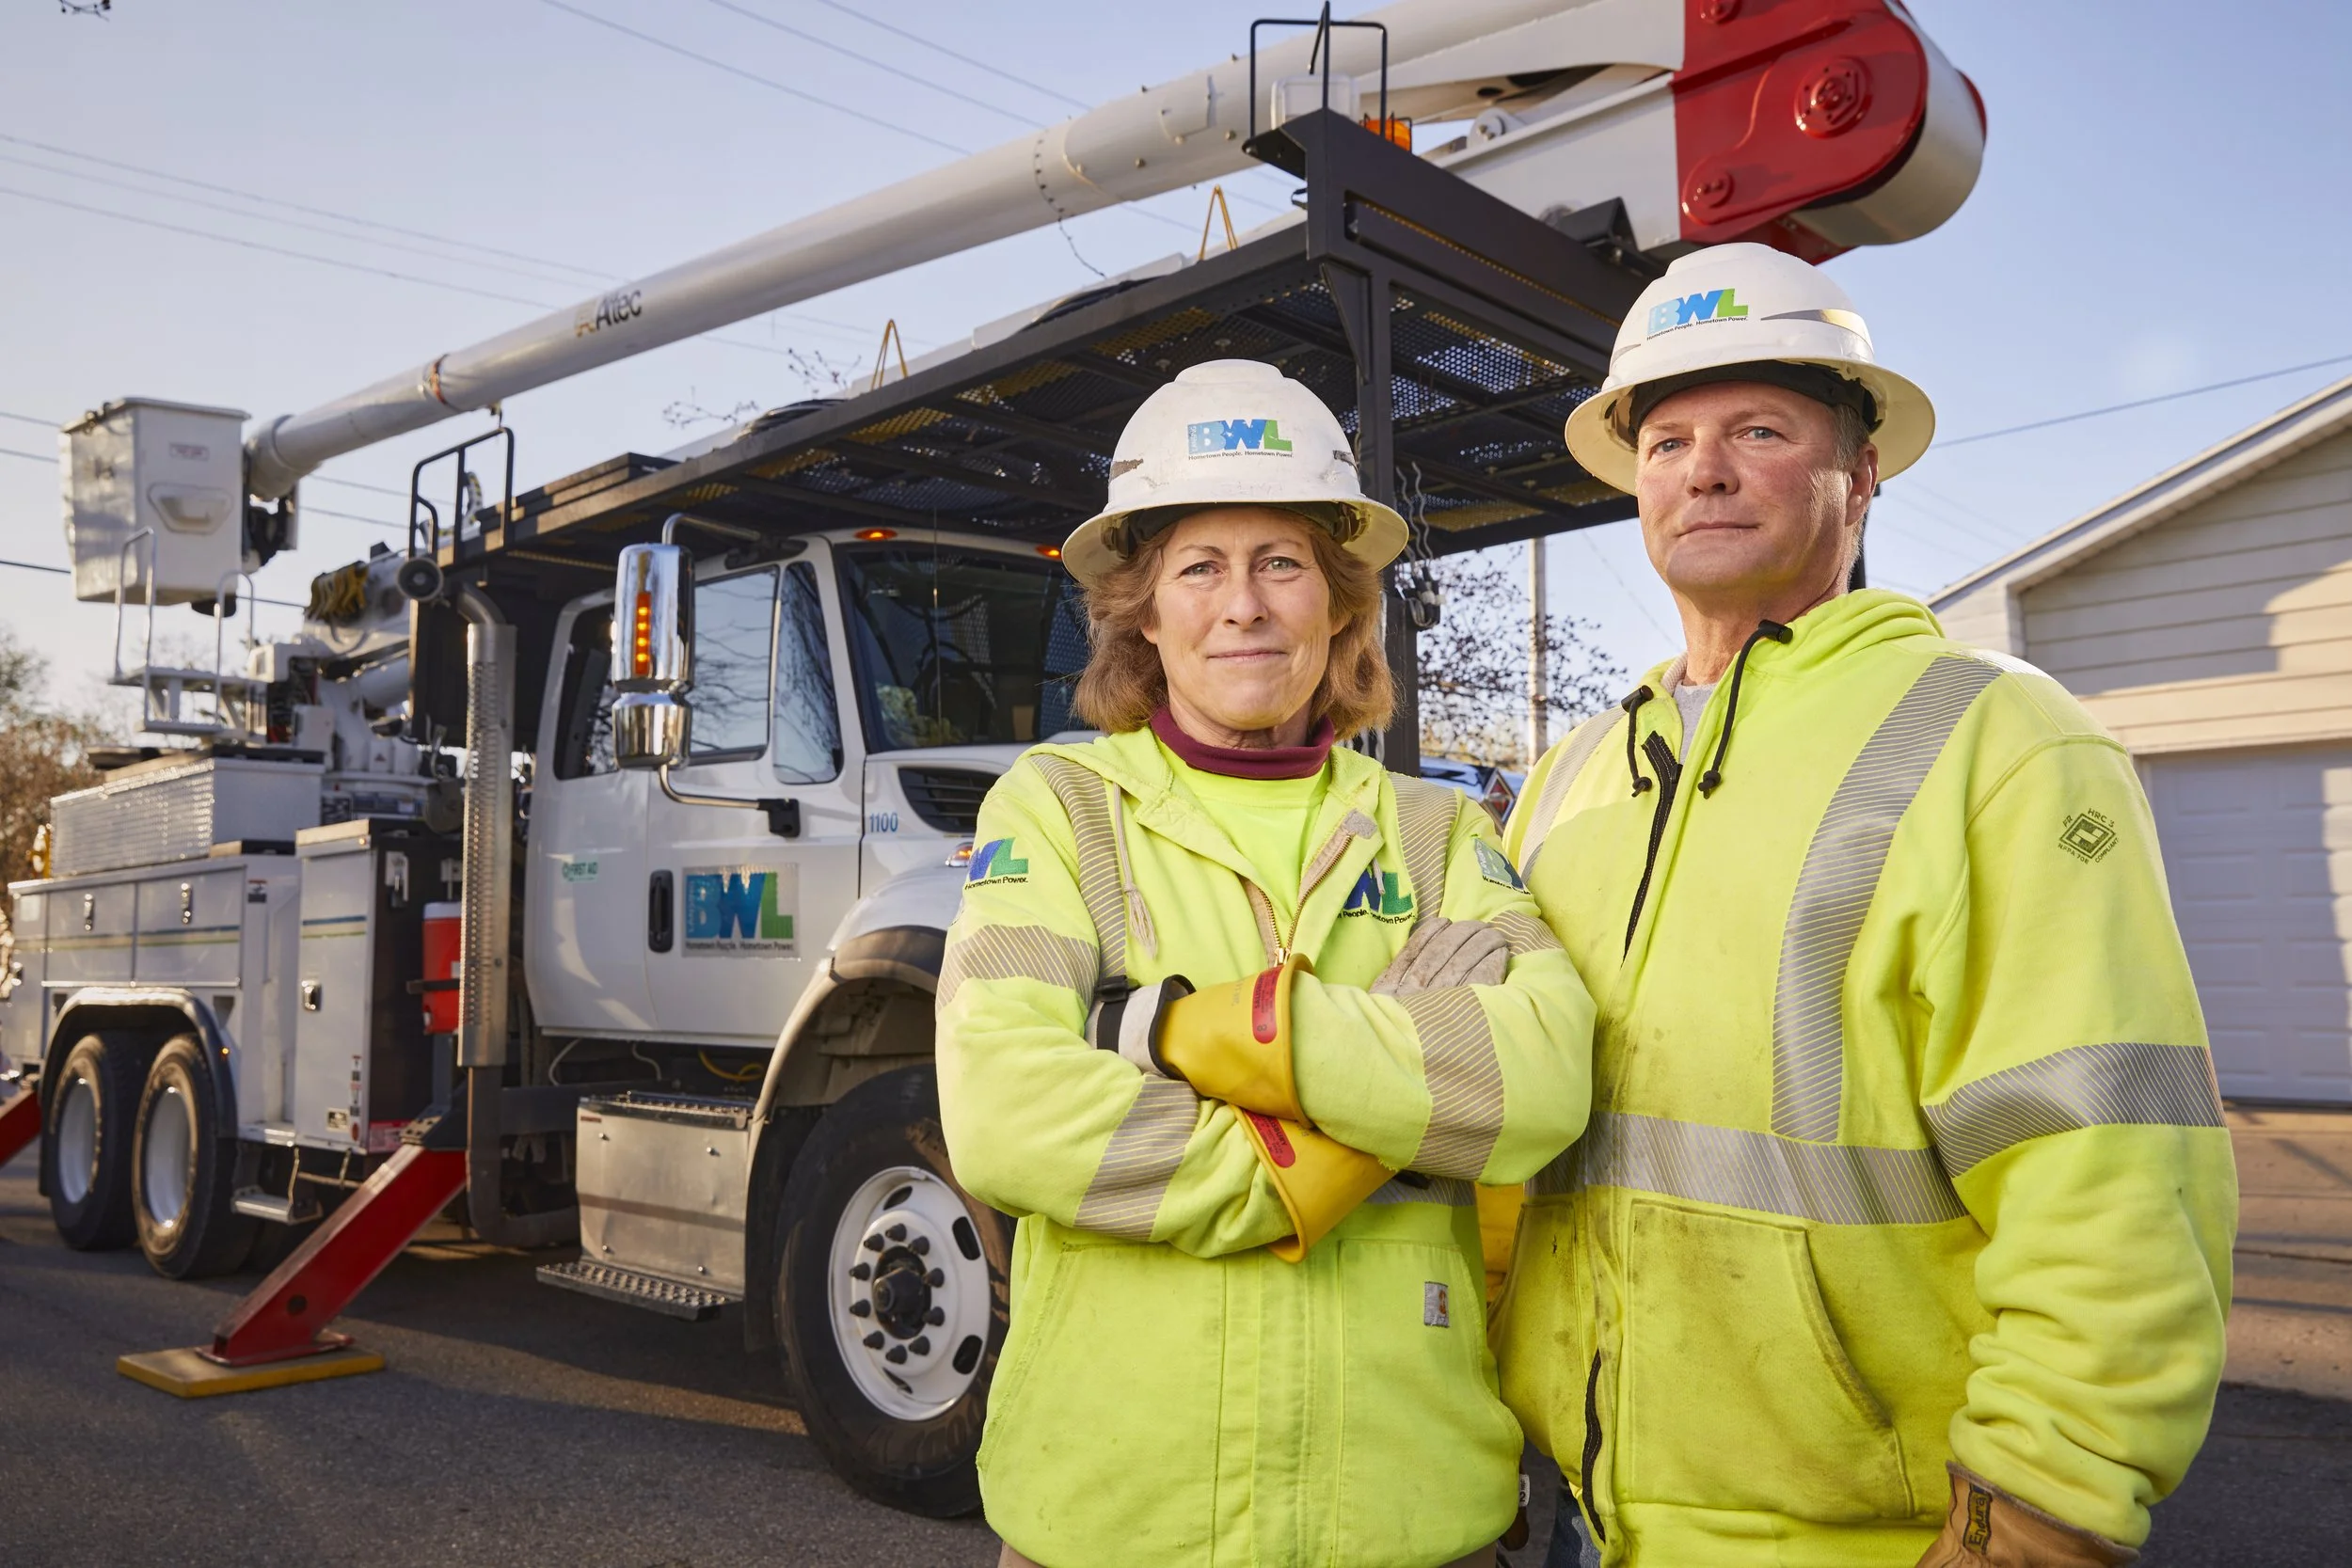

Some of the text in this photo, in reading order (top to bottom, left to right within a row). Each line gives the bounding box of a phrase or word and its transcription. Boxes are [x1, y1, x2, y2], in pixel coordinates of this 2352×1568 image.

[1647, 288, 1749, 335] BWL
[1646, 326, 1674, 341] Hometown
[1674, 323, 1693, 332] People.
[1695, 318, 1727, 326] Hometown
[1187, 420, 1293, 454] BWL
[869, 812, 898, 833] 1100
[2062, 815, 2074, 828] FR
[2088, 808, 2107, 823] HRC
[969, 837, 1028, 881] WL
[2058, 843, 2090, 864] NFPA 70E
[2094, 837, 2120, 863] COMPLIANT
[964, 876, 1028, 890] Hometown Power.
[1343, 869, 1414, 915] WL
[686, 872, 794, 939] BWL
[1968, 1497, 1986, 1545] Endura
